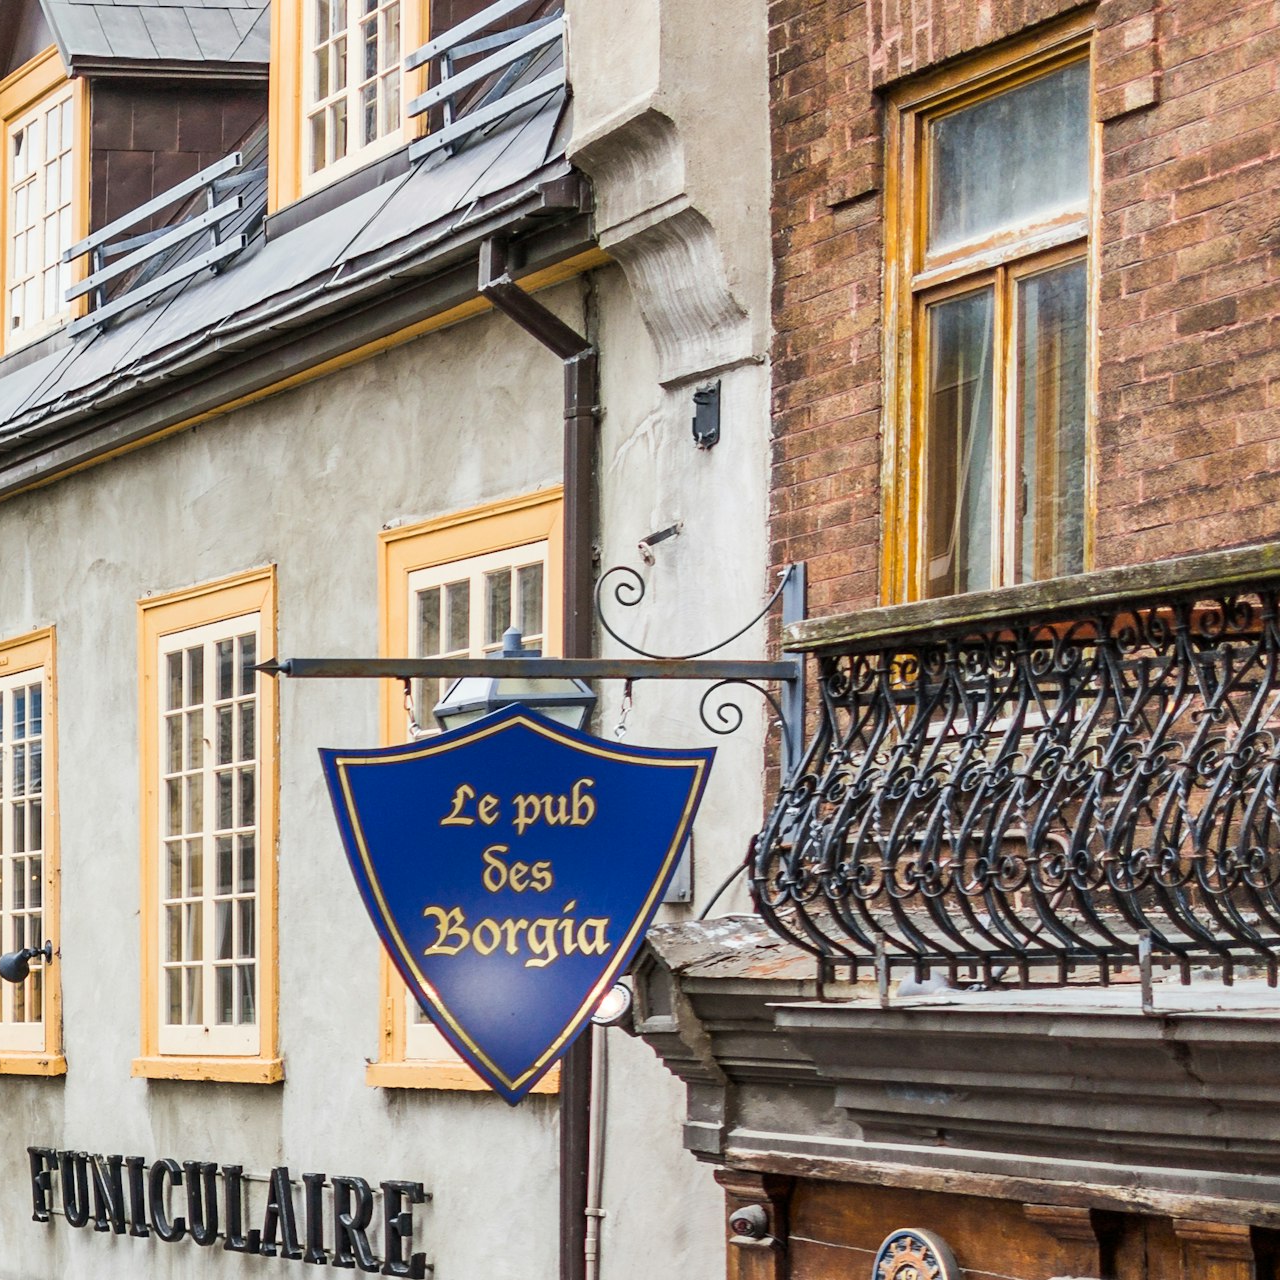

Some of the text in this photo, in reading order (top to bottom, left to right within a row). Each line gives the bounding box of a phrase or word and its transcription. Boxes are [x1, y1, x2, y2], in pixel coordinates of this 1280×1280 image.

[440, 778, 596, 835] Le pub
[481, 845, 553, 892] des
[424, 900, 610, 968] Borgia
[27, 1146, 427, 1280] FUNICULAIRE
